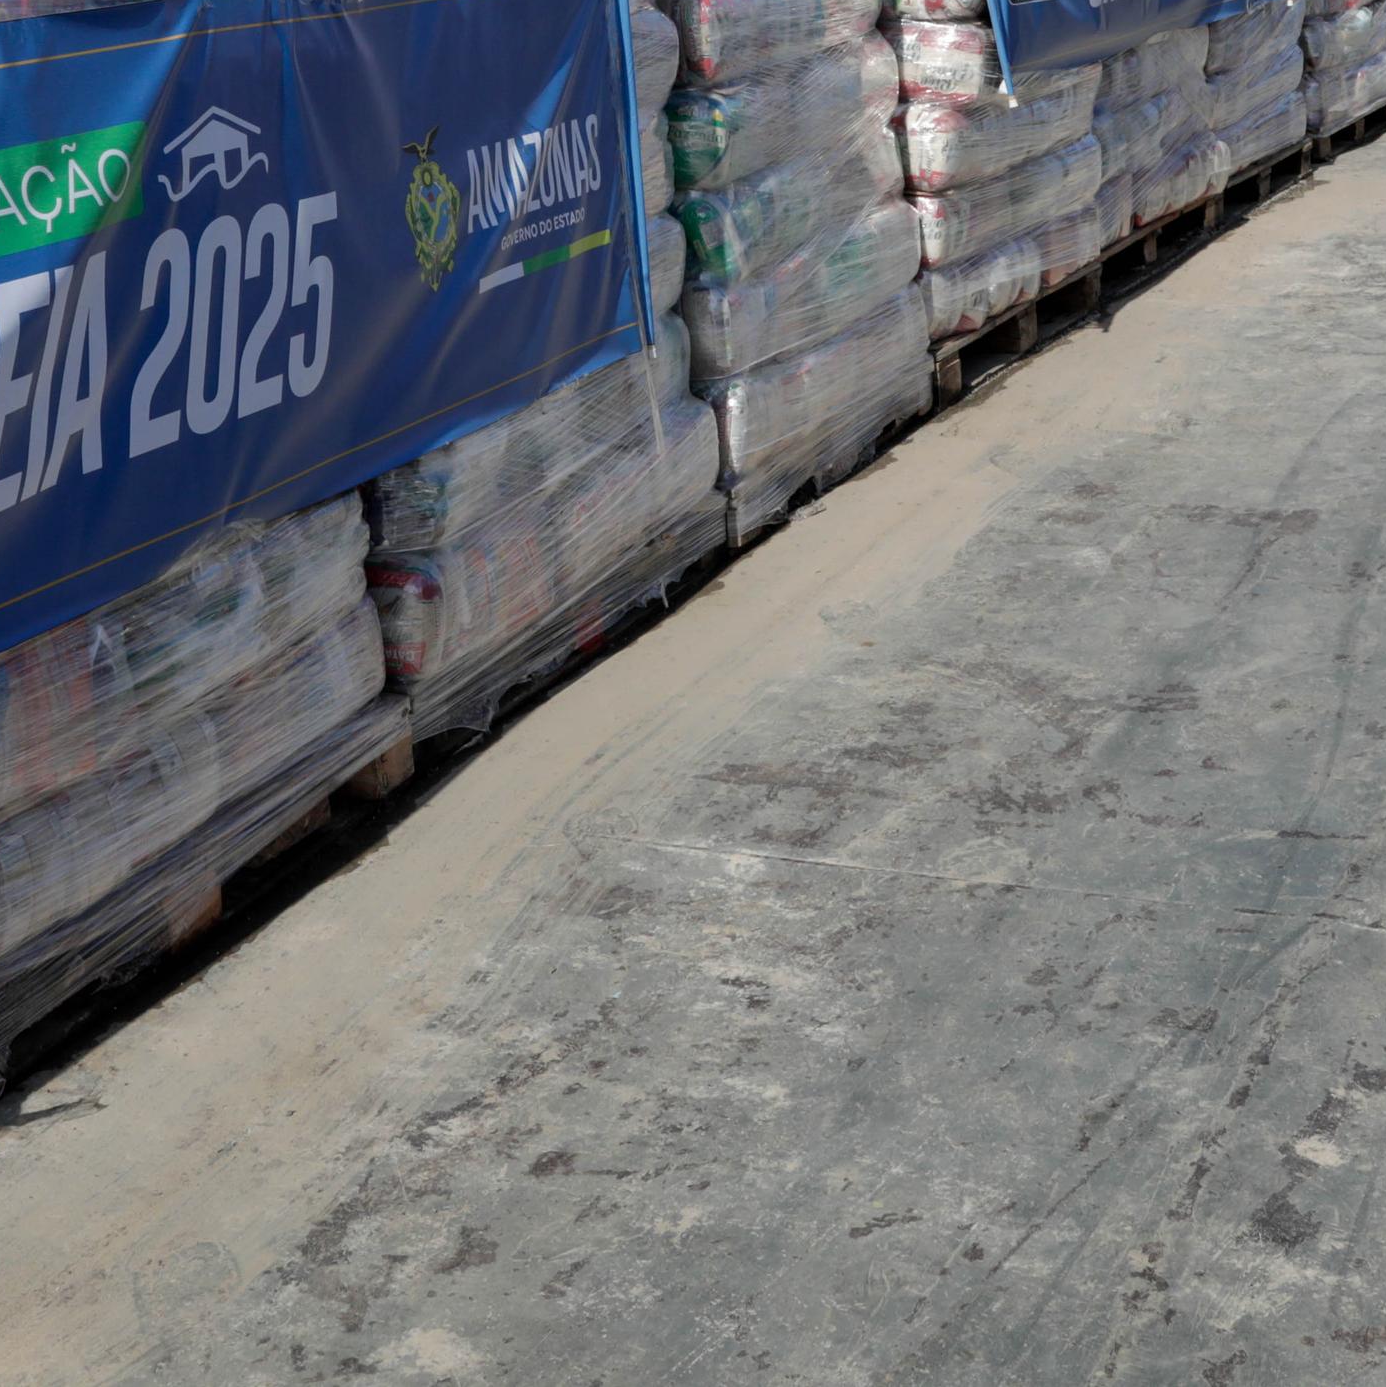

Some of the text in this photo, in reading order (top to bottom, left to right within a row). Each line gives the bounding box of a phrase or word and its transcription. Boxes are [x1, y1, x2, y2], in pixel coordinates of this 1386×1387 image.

[466, 114, 602, 234] AMAZONAS
[500, 207, 586, 252] GOVERNO DO ESTADO
[128, 190, 338, 459] 2025
